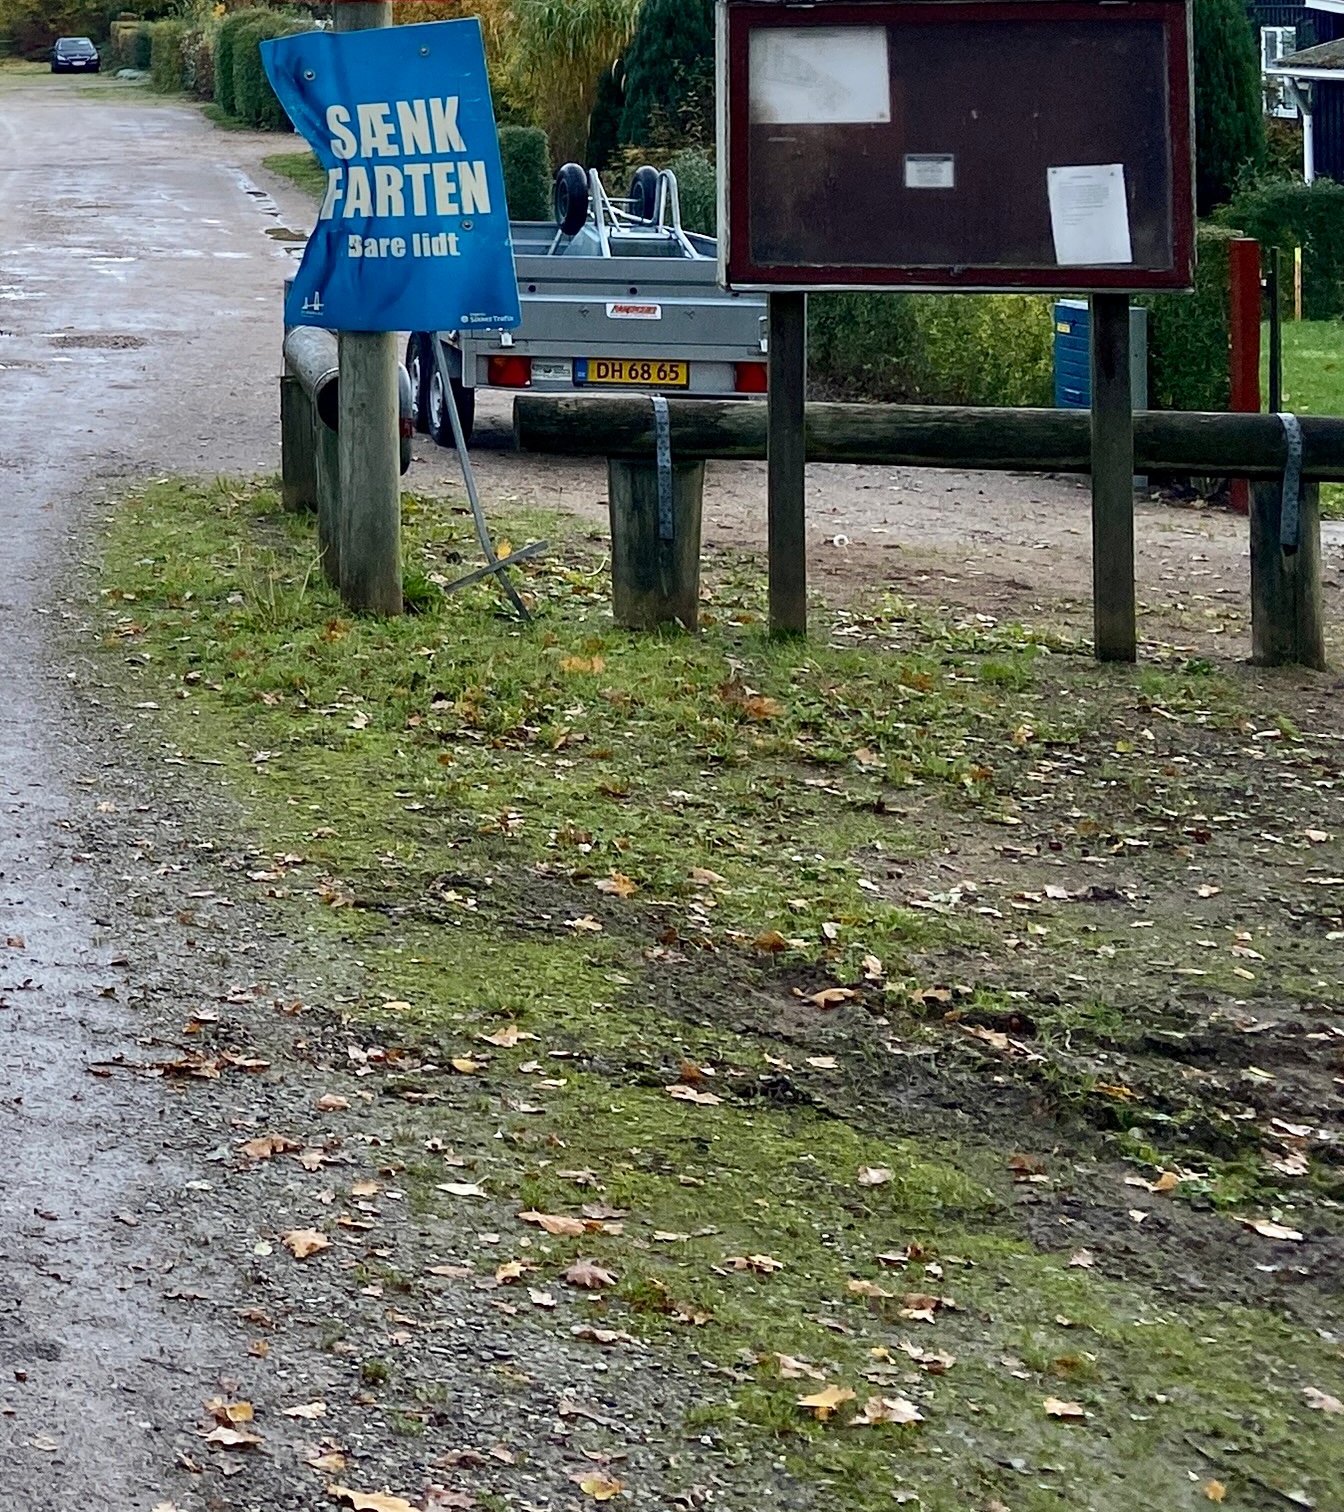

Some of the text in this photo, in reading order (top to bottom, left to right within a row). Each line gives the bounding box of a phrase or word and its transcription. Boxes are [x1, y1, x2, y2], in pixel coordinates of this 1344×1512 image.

[326, 95, 467, 160] SÆNK
[319, 160, 492, 221] FARTEN
[348, 232, 461, 258] Bare lidt
[596, 361, 680, 381] DH 68 65
